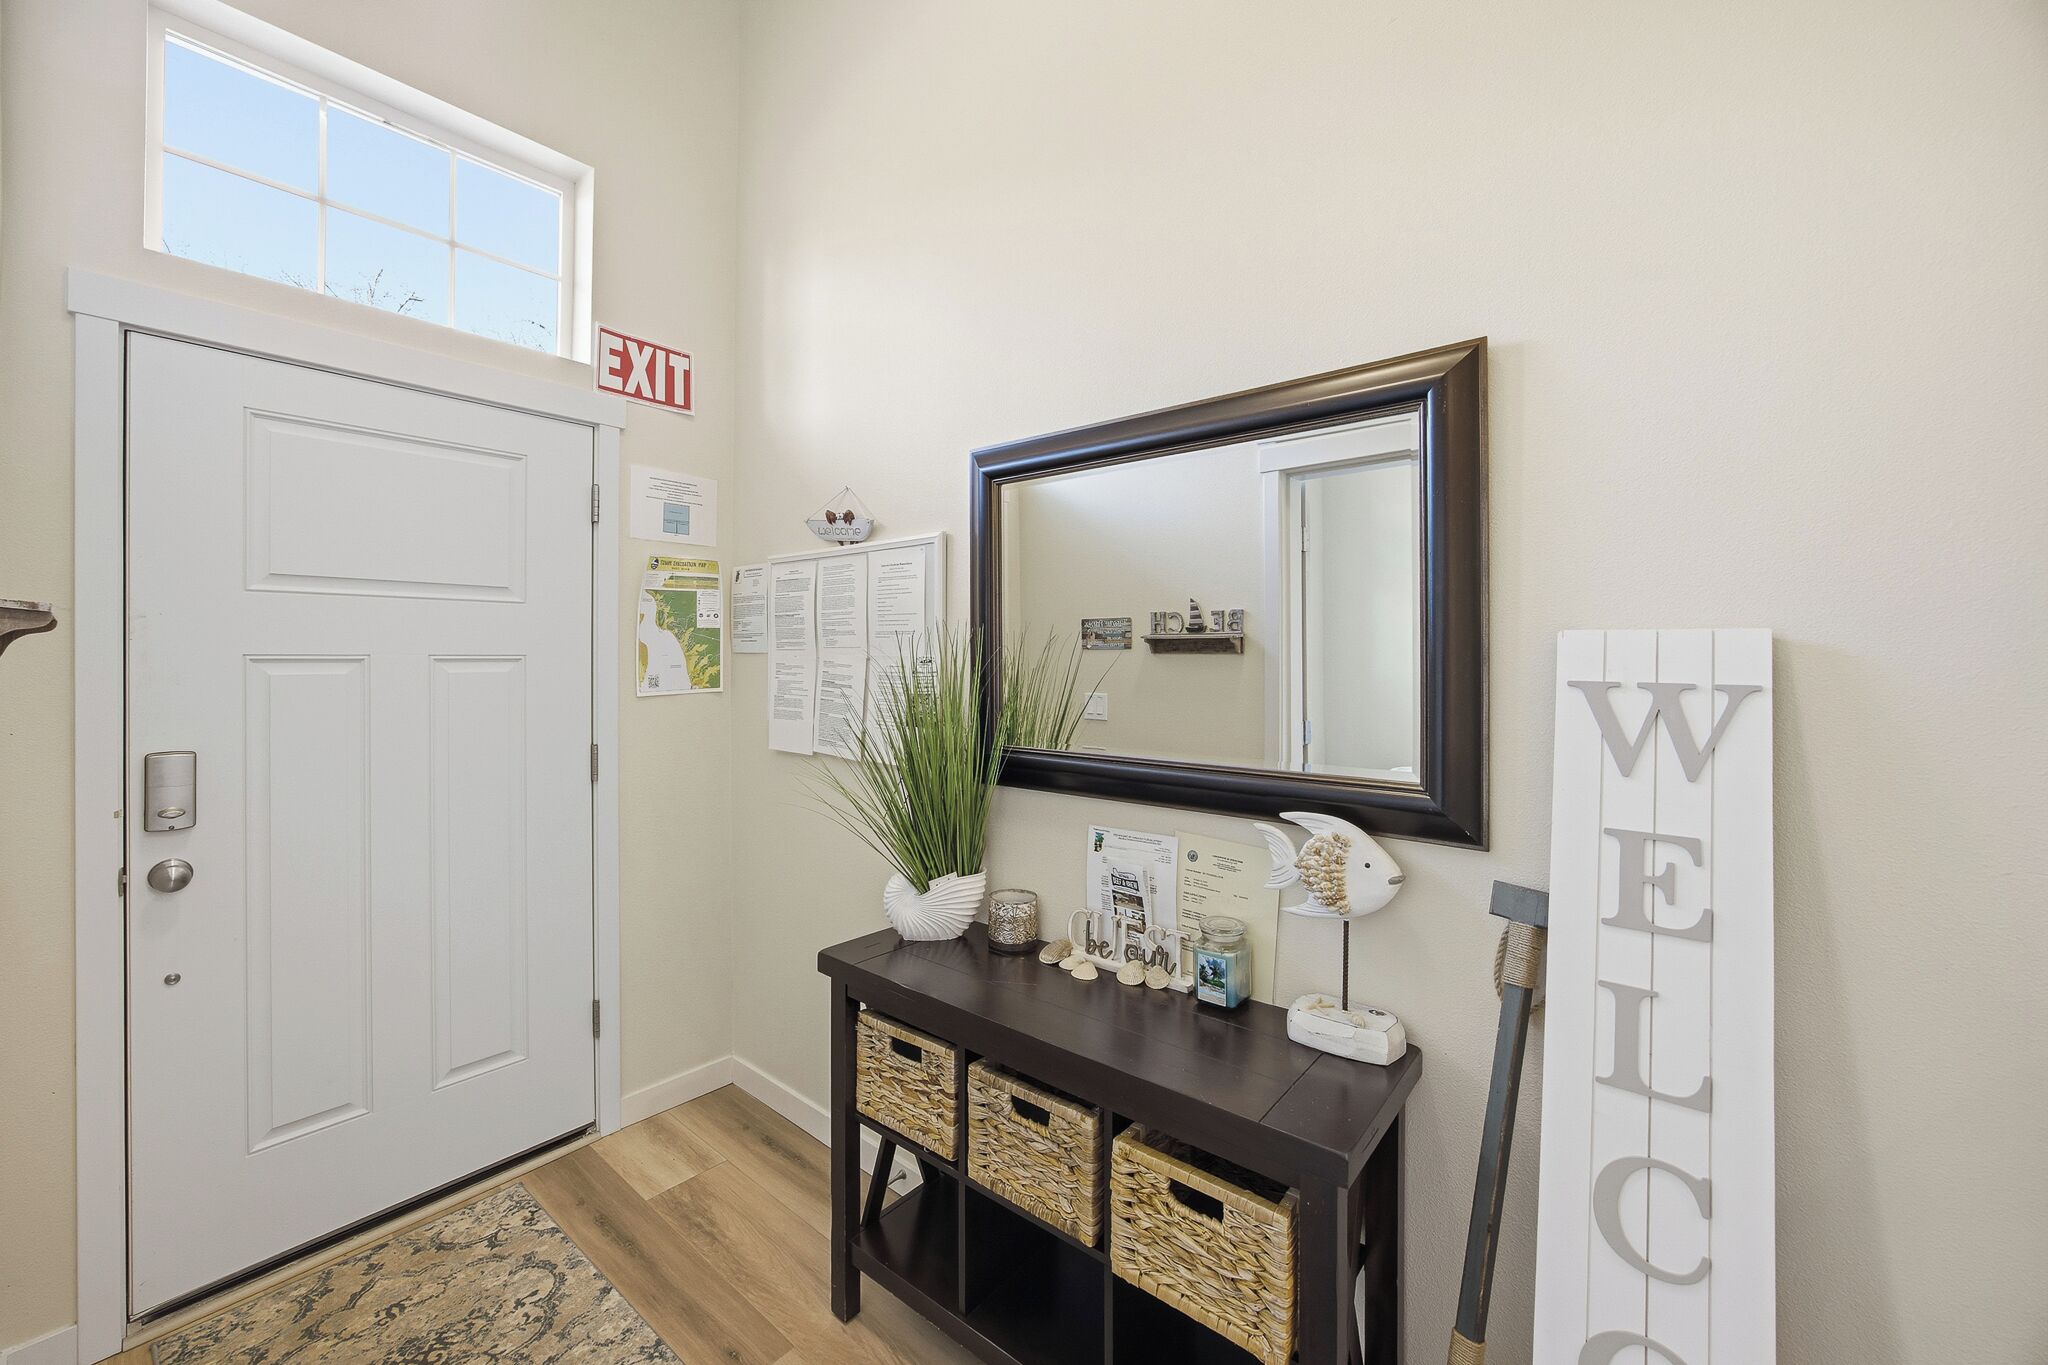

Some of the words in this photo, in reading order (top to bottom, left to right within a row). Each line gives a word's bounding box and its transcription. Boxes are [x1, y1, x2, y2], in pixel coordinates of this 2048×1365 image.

[599, 331, 690, 406] EXIT
[817, 527, 861, 536] welcome
[1085, 919, 1113, 959] be
[1567, 681, 1763, 1365] WELC
